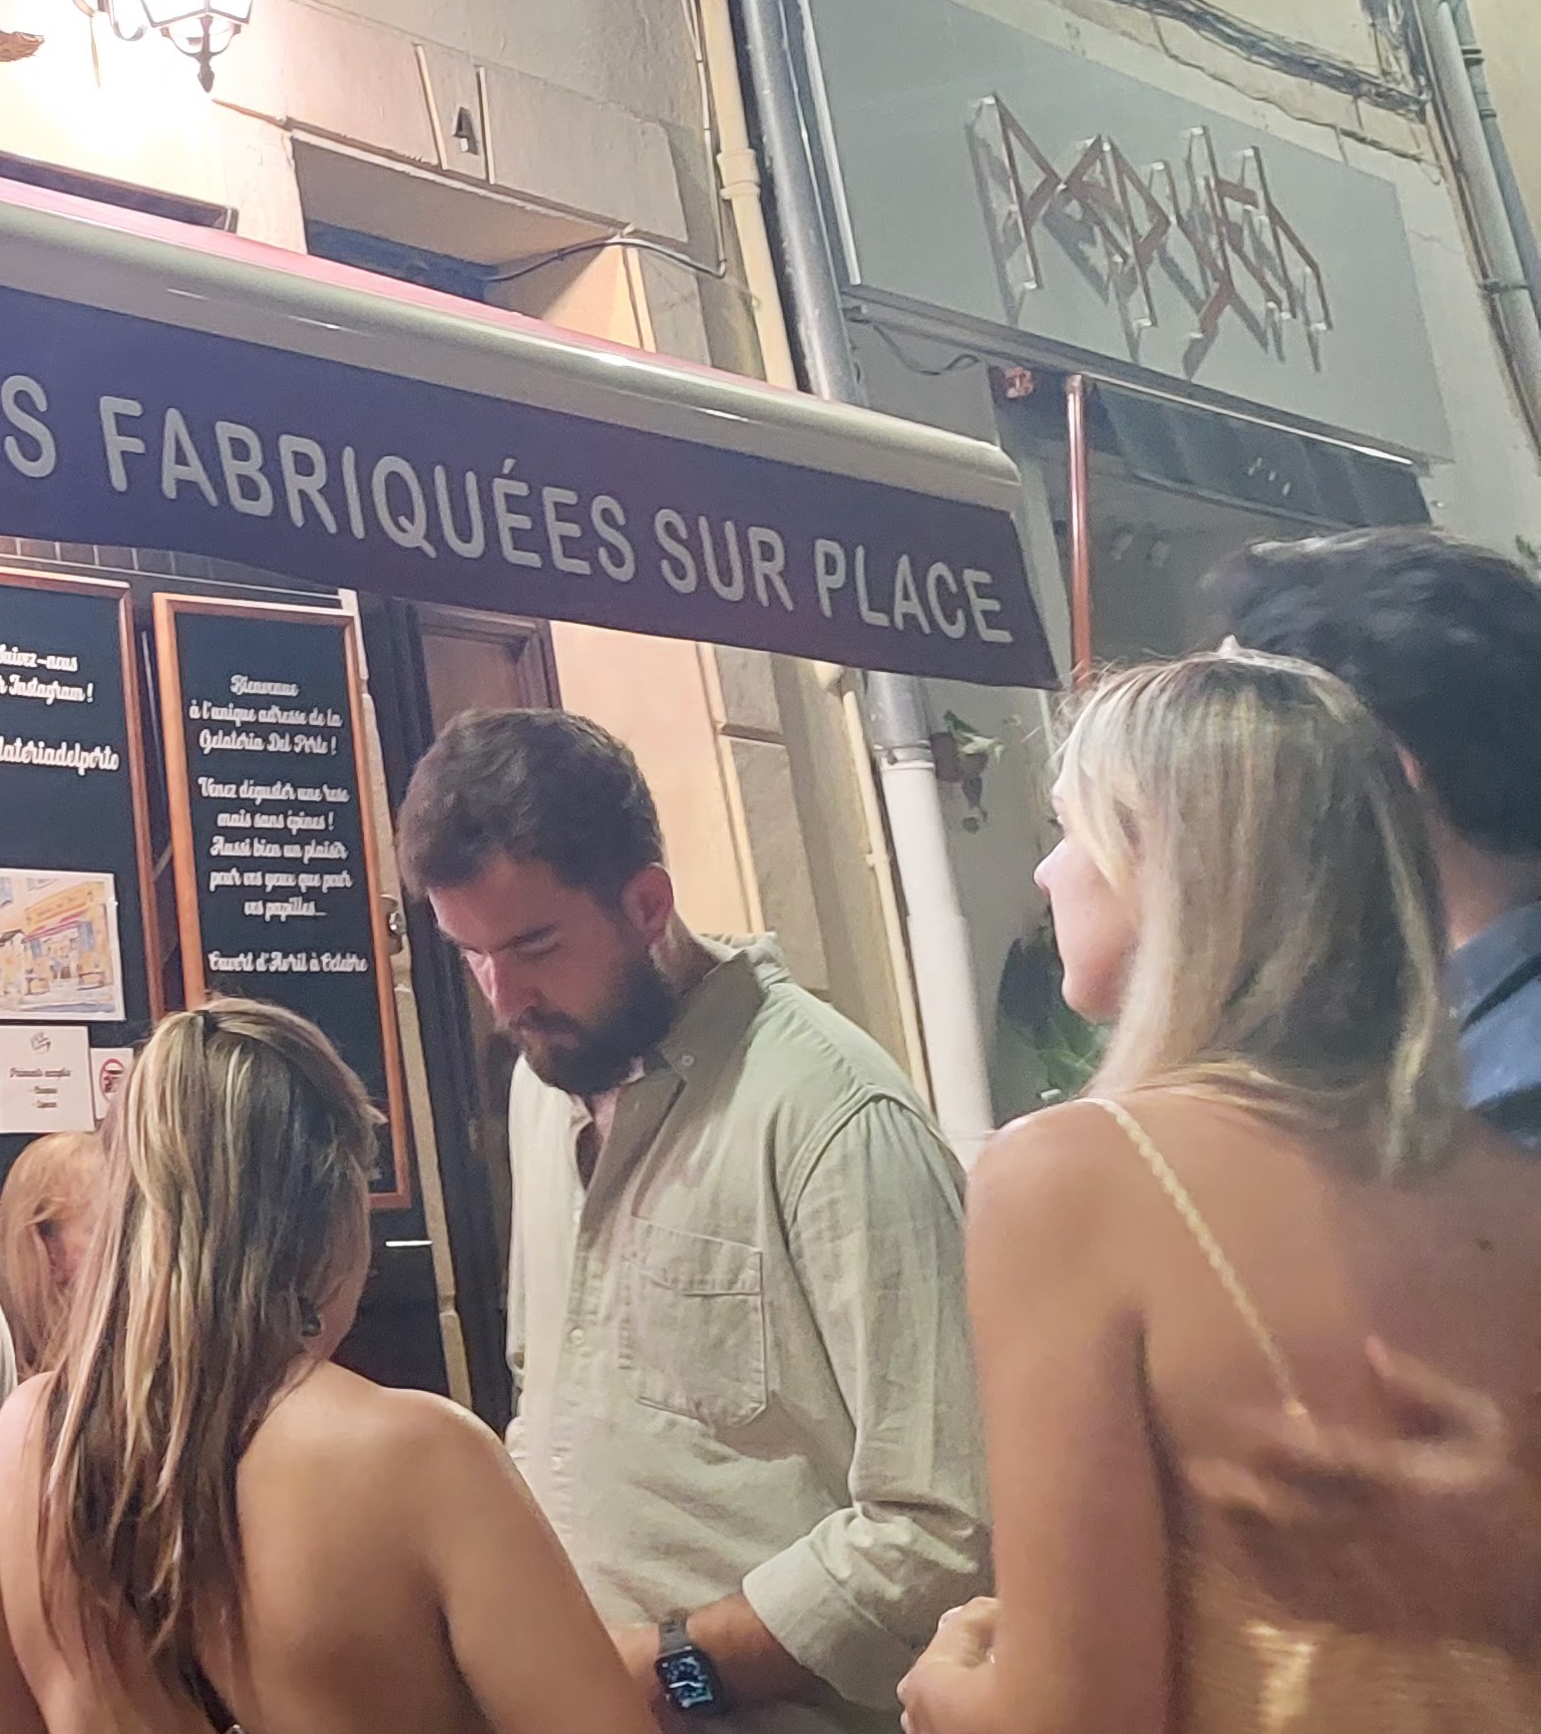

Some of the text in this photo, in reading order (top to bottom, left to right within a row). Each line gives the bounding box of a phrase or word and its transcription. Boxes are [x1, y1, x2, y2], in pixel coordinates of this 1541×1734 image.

[101, 395, 633, 582] FABRIQUÉES
[653, 507, 790, 602] SUR
[816, 537, 1012, 645] PLACE
[8, 674, 85, 705] Instagram
